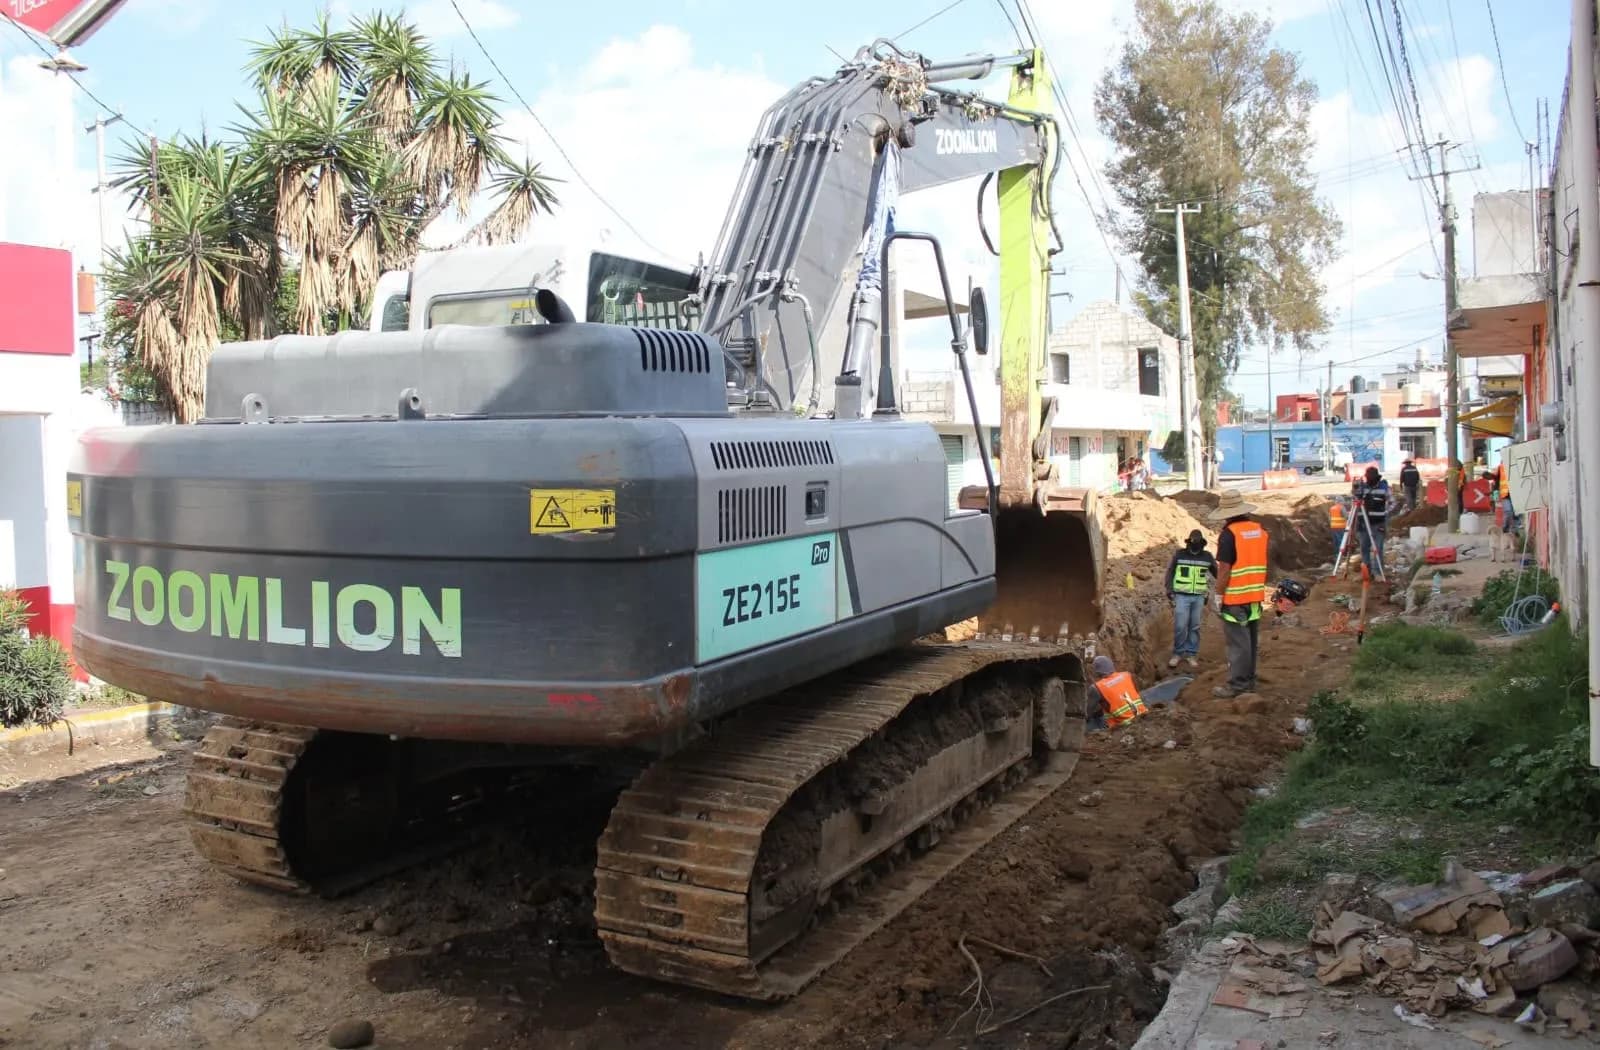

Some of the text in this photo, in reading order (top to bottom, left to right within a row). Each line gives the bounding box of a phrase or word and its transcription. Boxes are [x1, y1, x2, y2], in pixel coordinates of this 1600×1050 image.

[936, 129, 997, 154] ZOOMLION
[814, 546, 828, 563] Pro
[106, 560, 462, 657] ZOOMLION
[723, 574, 800, 627] ZE215E
